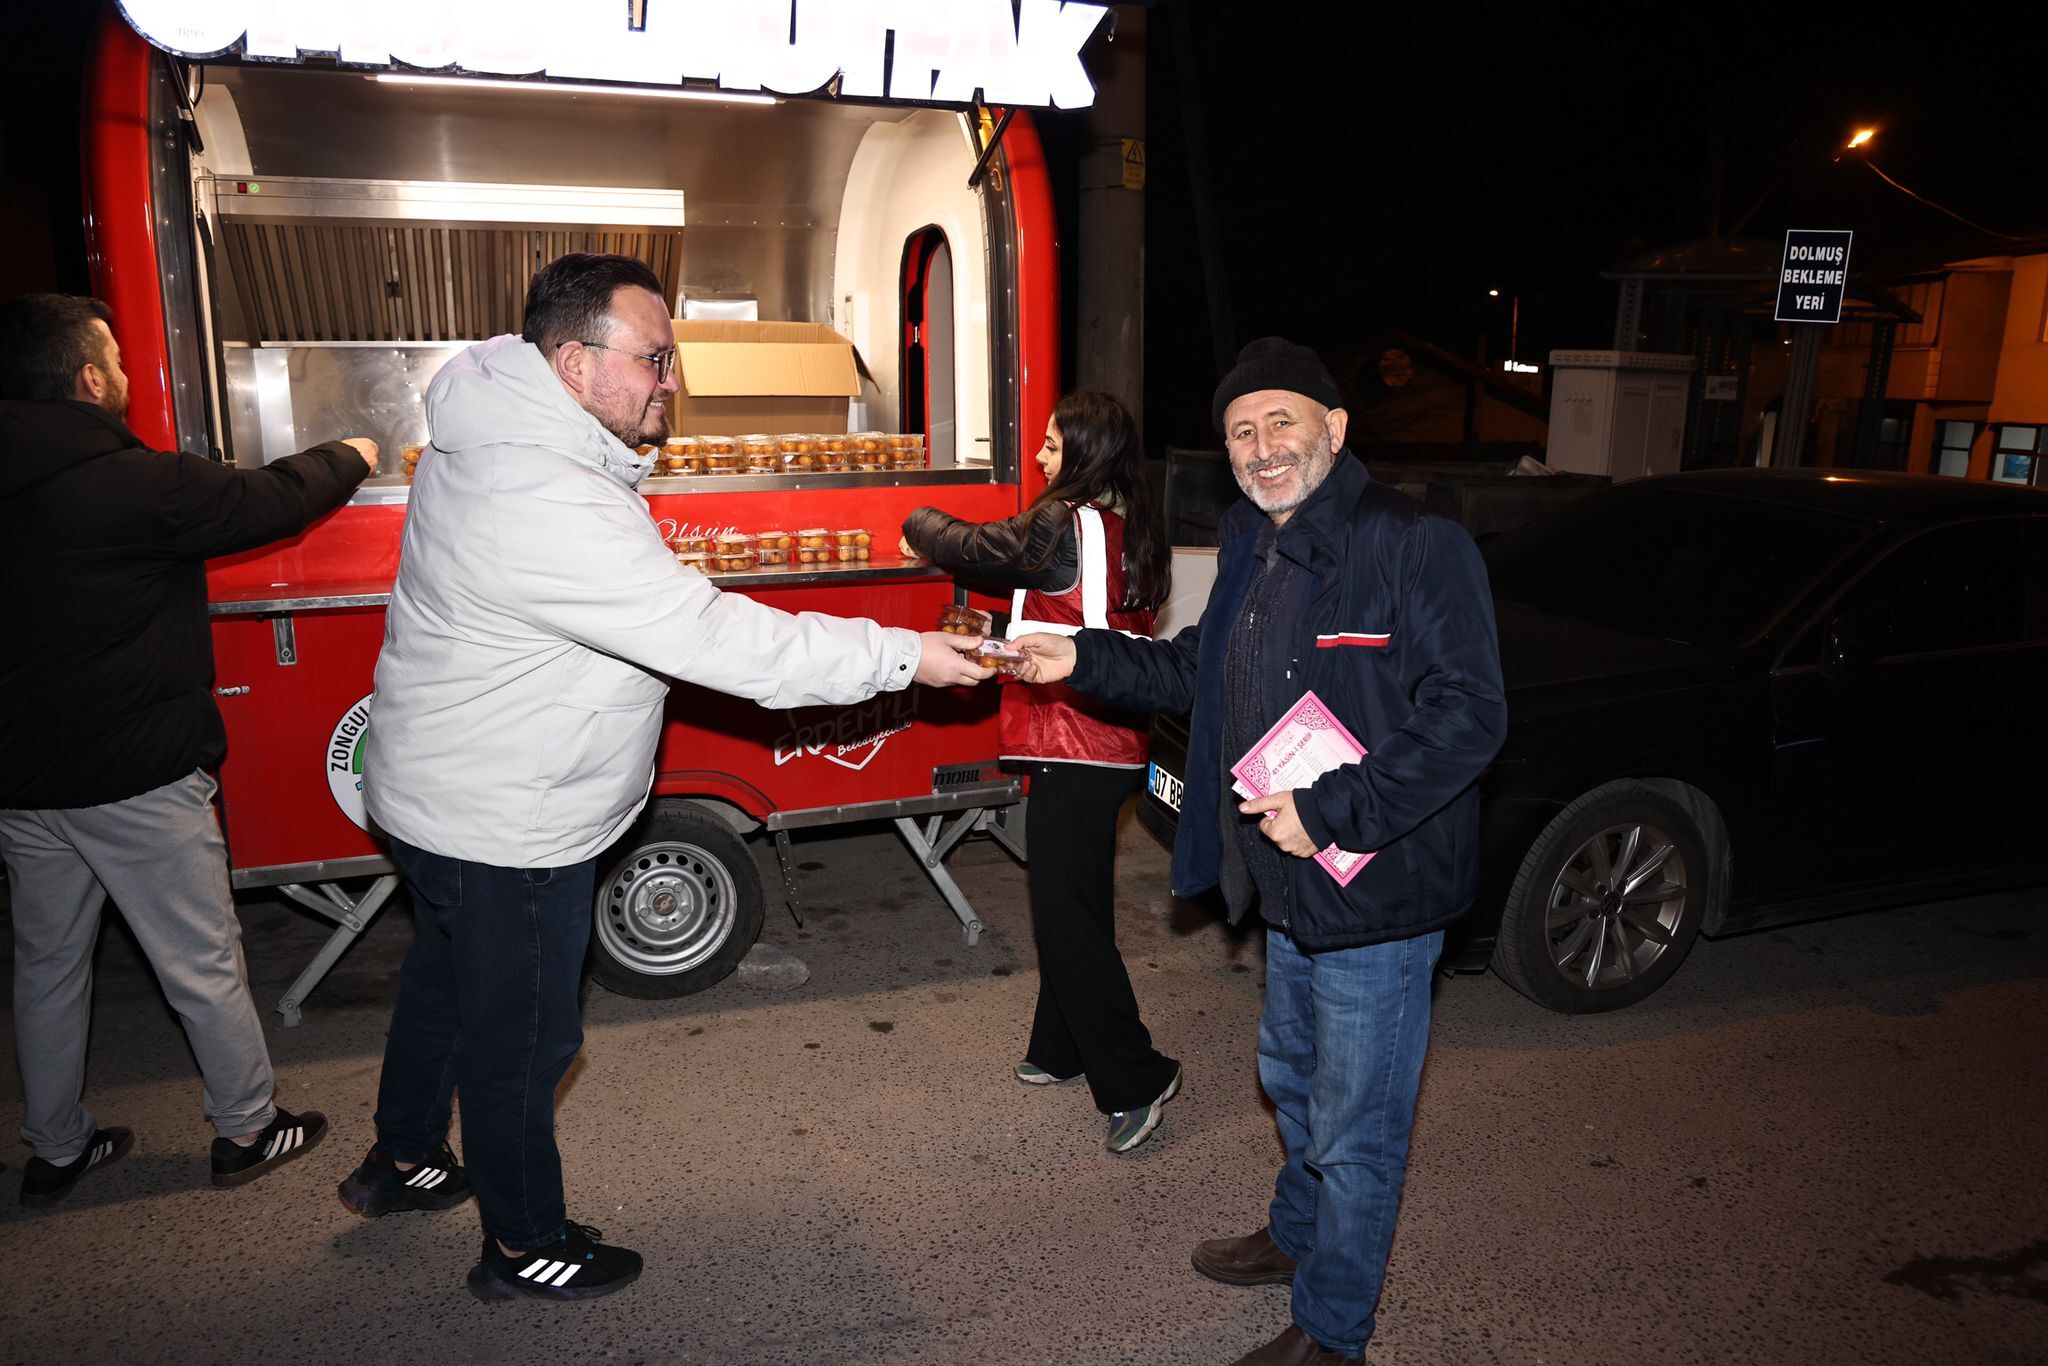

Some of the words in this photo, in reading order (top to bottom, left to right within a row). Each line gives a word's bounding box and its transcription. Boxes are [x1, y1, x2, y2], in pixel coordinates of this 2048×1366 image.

[1789, 245, 1843, 265] DOLMUŞ
[1783, 268, 1843, 285] BEKLEME
[1795, 291, 1825, 310] YERİ
[1155, 768, 1167, 798] 07
